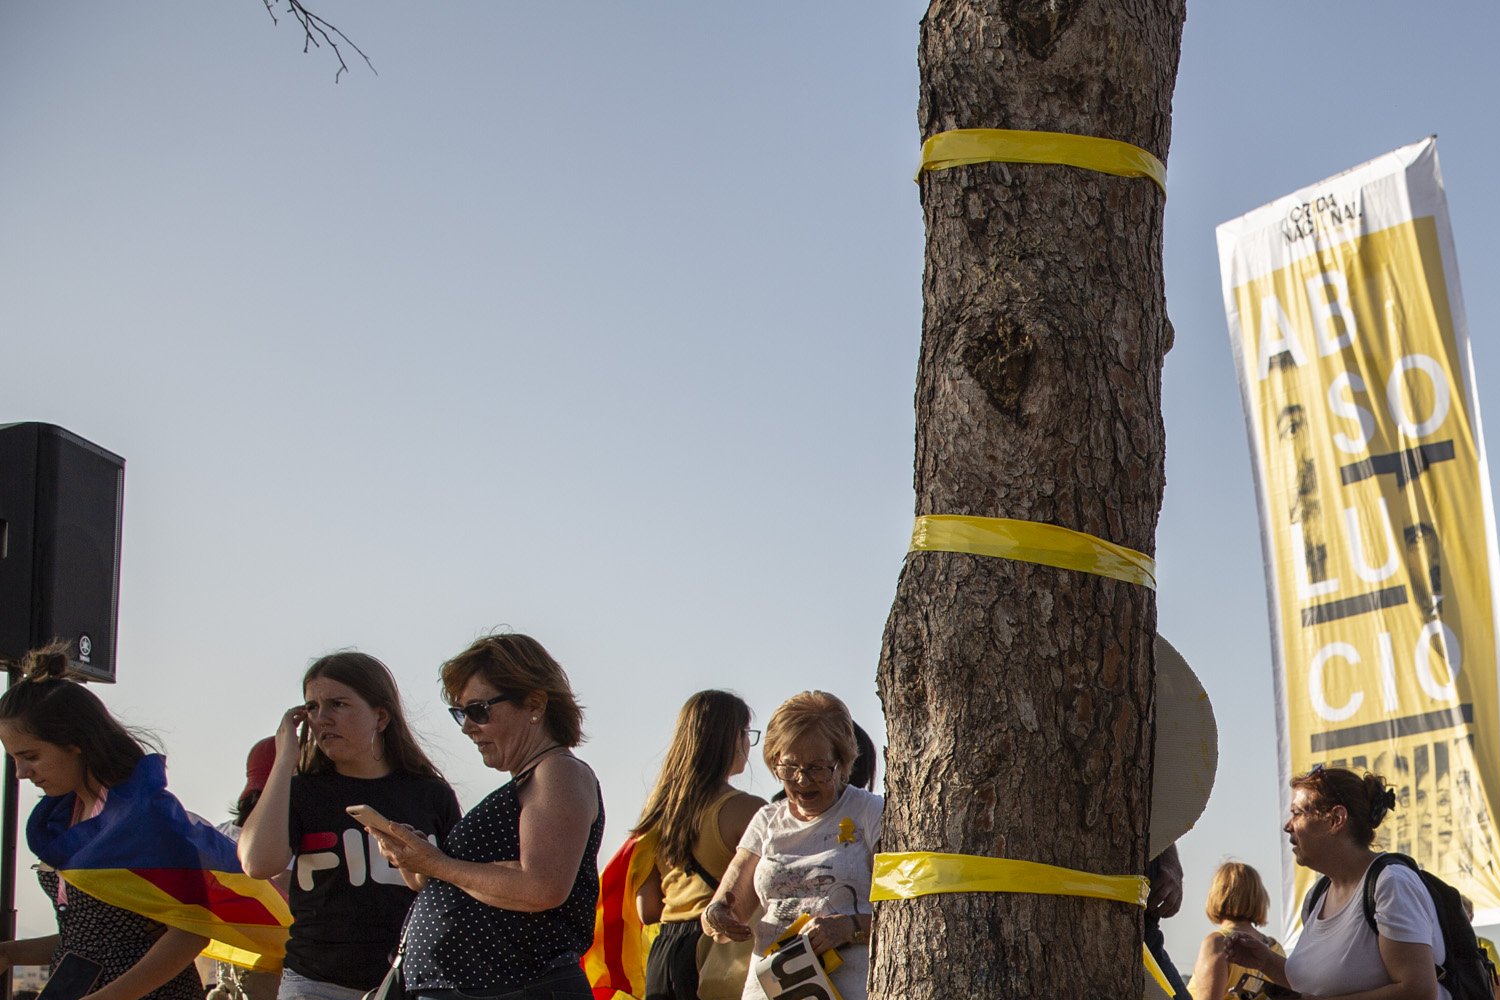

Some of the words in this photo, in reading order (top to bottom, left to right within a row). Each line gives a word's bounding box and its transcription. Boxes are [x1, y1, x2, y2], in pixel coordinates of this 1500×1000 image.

[1327, 353, 1451, 454] SO
[1289, 496, 1400, 601] LU
[297, 828, 437, 891] FIL
